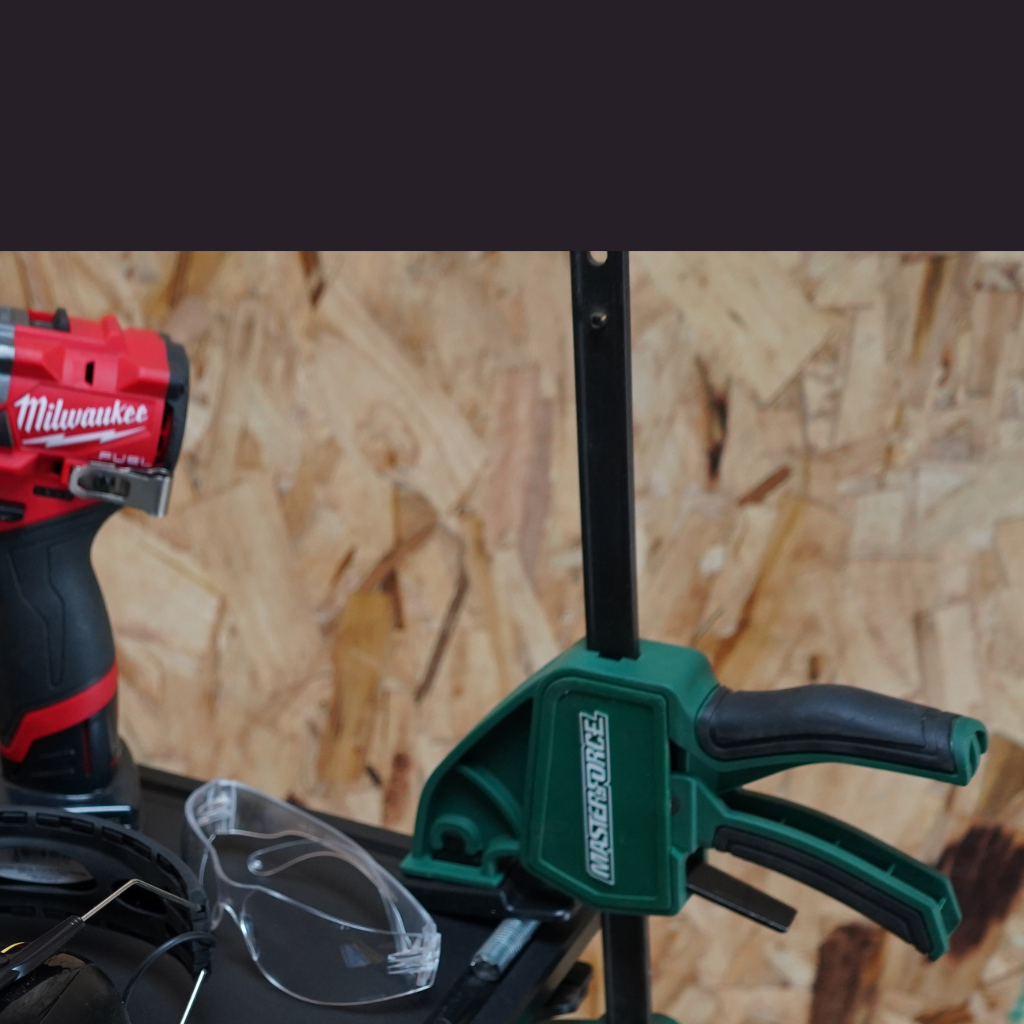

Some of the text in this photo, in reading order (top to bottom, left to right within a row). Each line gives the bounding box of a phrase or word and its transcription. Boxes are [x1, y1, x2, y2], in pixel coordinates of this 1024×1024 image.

[14, 393, 148, 433] Milwaukee
[98, 450, 152, 467] FUEL
[581, 713, 612, 882] MASTERFORCE
